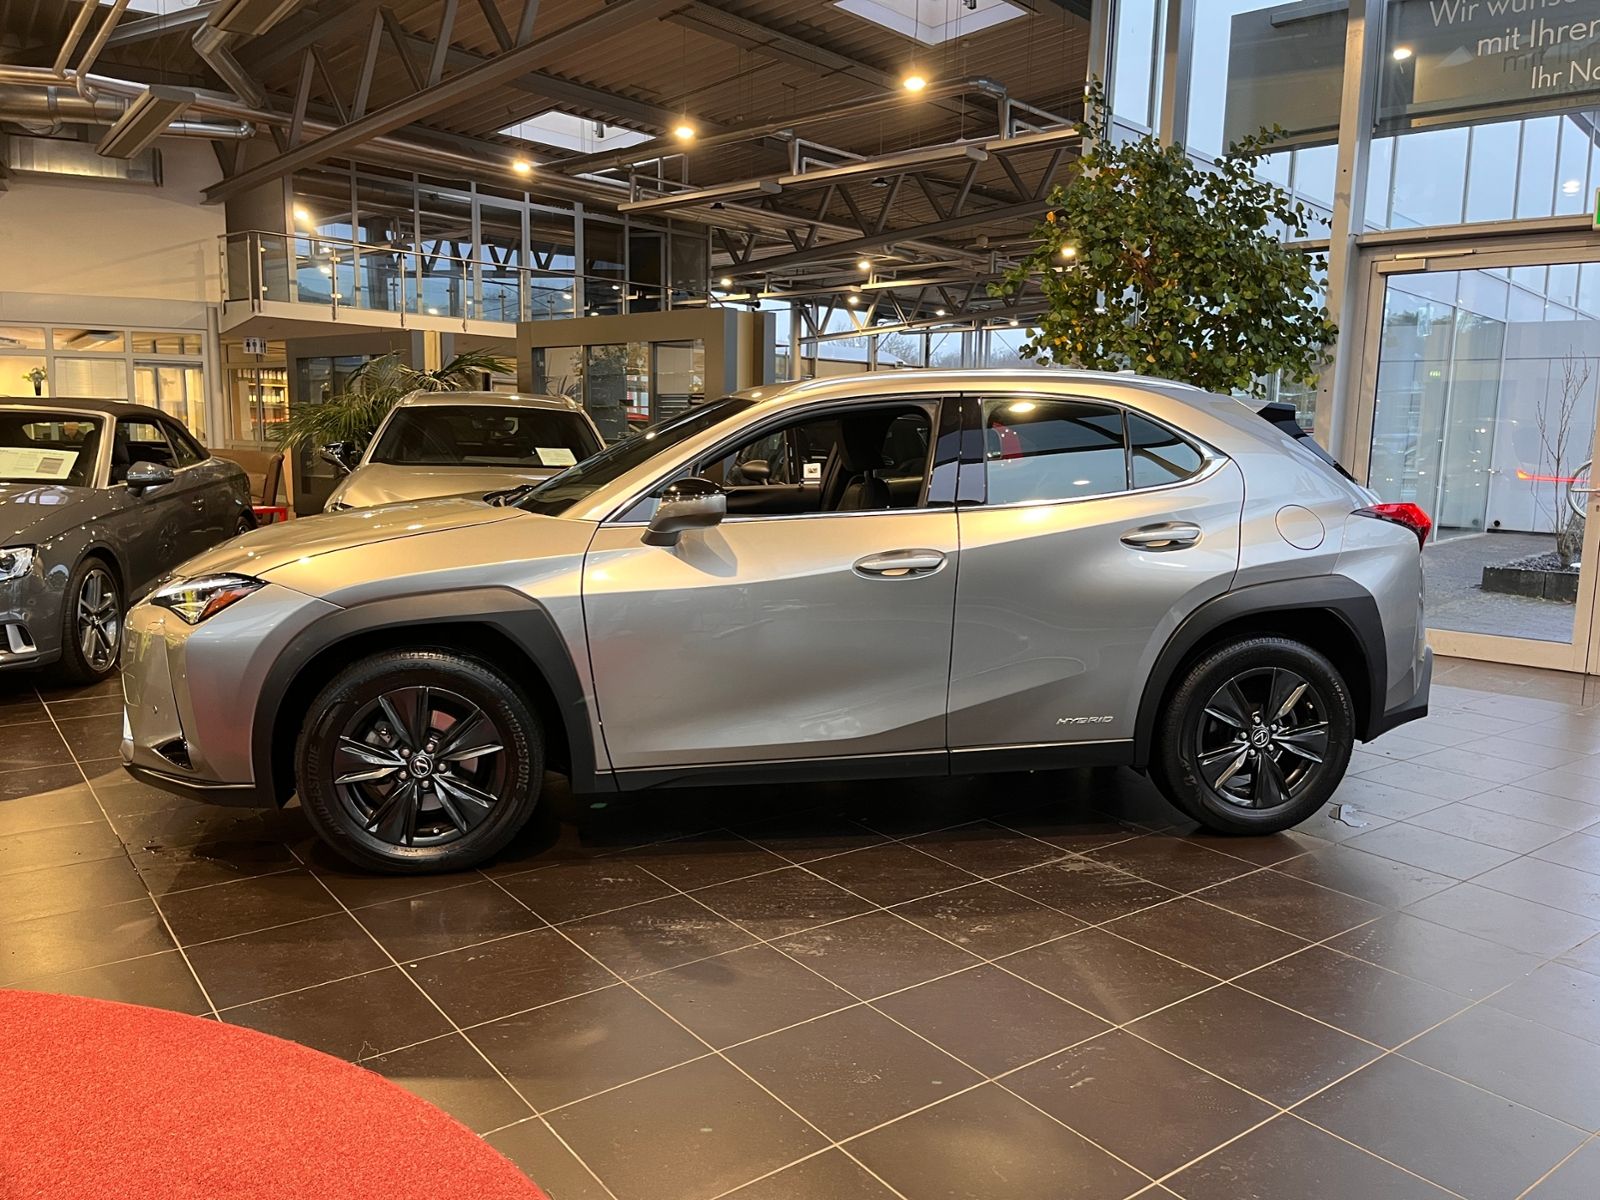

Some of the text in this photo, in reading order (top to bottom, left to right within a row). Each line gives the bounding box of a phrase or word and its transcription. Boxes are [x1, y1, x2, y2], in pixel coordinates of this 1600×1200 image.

[1429, 0, 1479, 27] Wir
[1477, 27, 1520, 56] mit
[1531, 65, 1563, 89] Ihr
[1056, 715, 1114, 725] HYBRID
